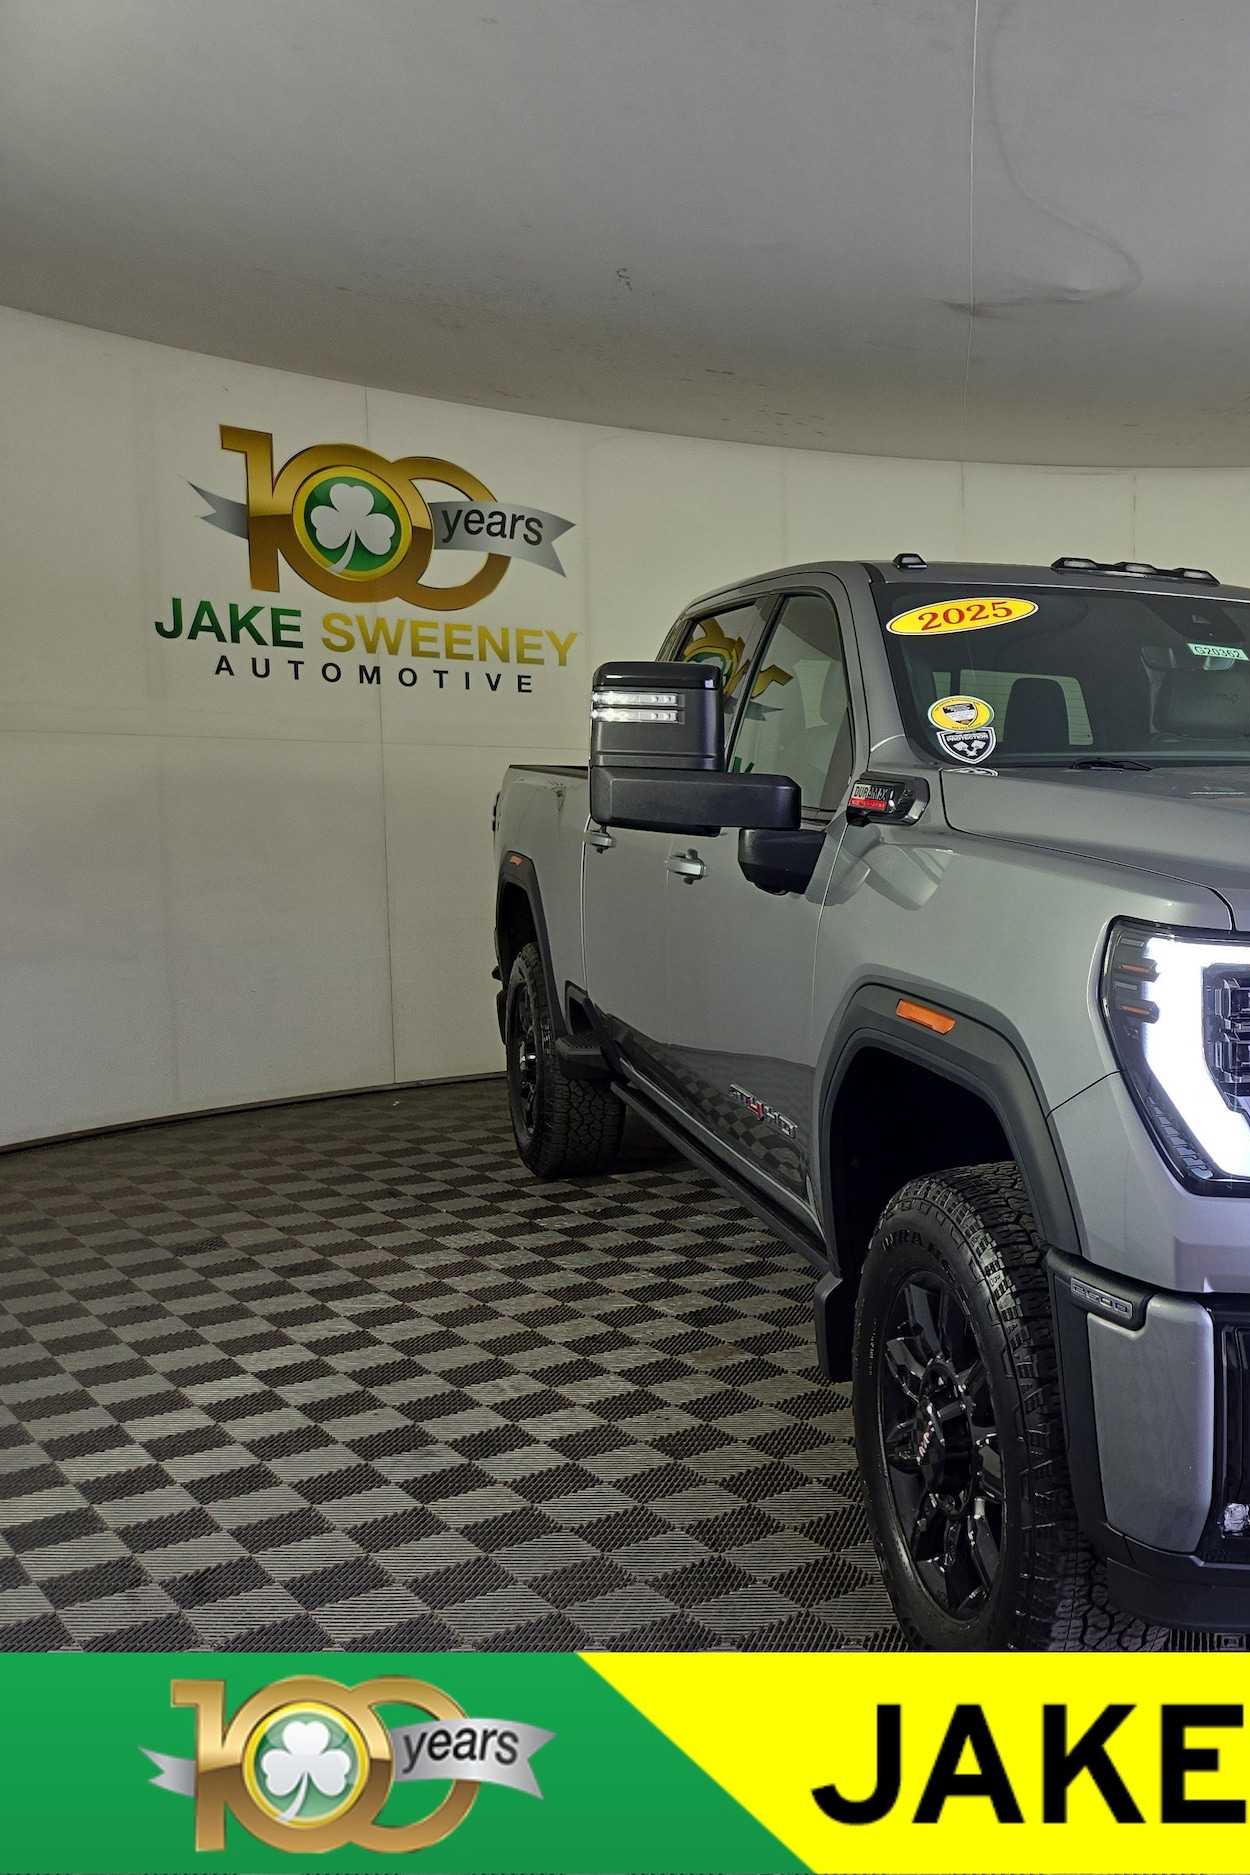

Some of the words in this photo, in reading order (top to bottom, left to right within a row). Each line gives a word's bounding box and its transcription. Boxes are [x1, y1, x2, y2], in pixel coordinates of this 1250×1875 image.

[219, 424, 512, 611] 100
[442, 507, 544, 546] years
[155, 597, 304, 649] JAKE
[321, 612, 579, 667] SWEENEY
[918, 601, 1013, 631] 2025
[214, 655, 533, 693] AUTOMOTIVE
